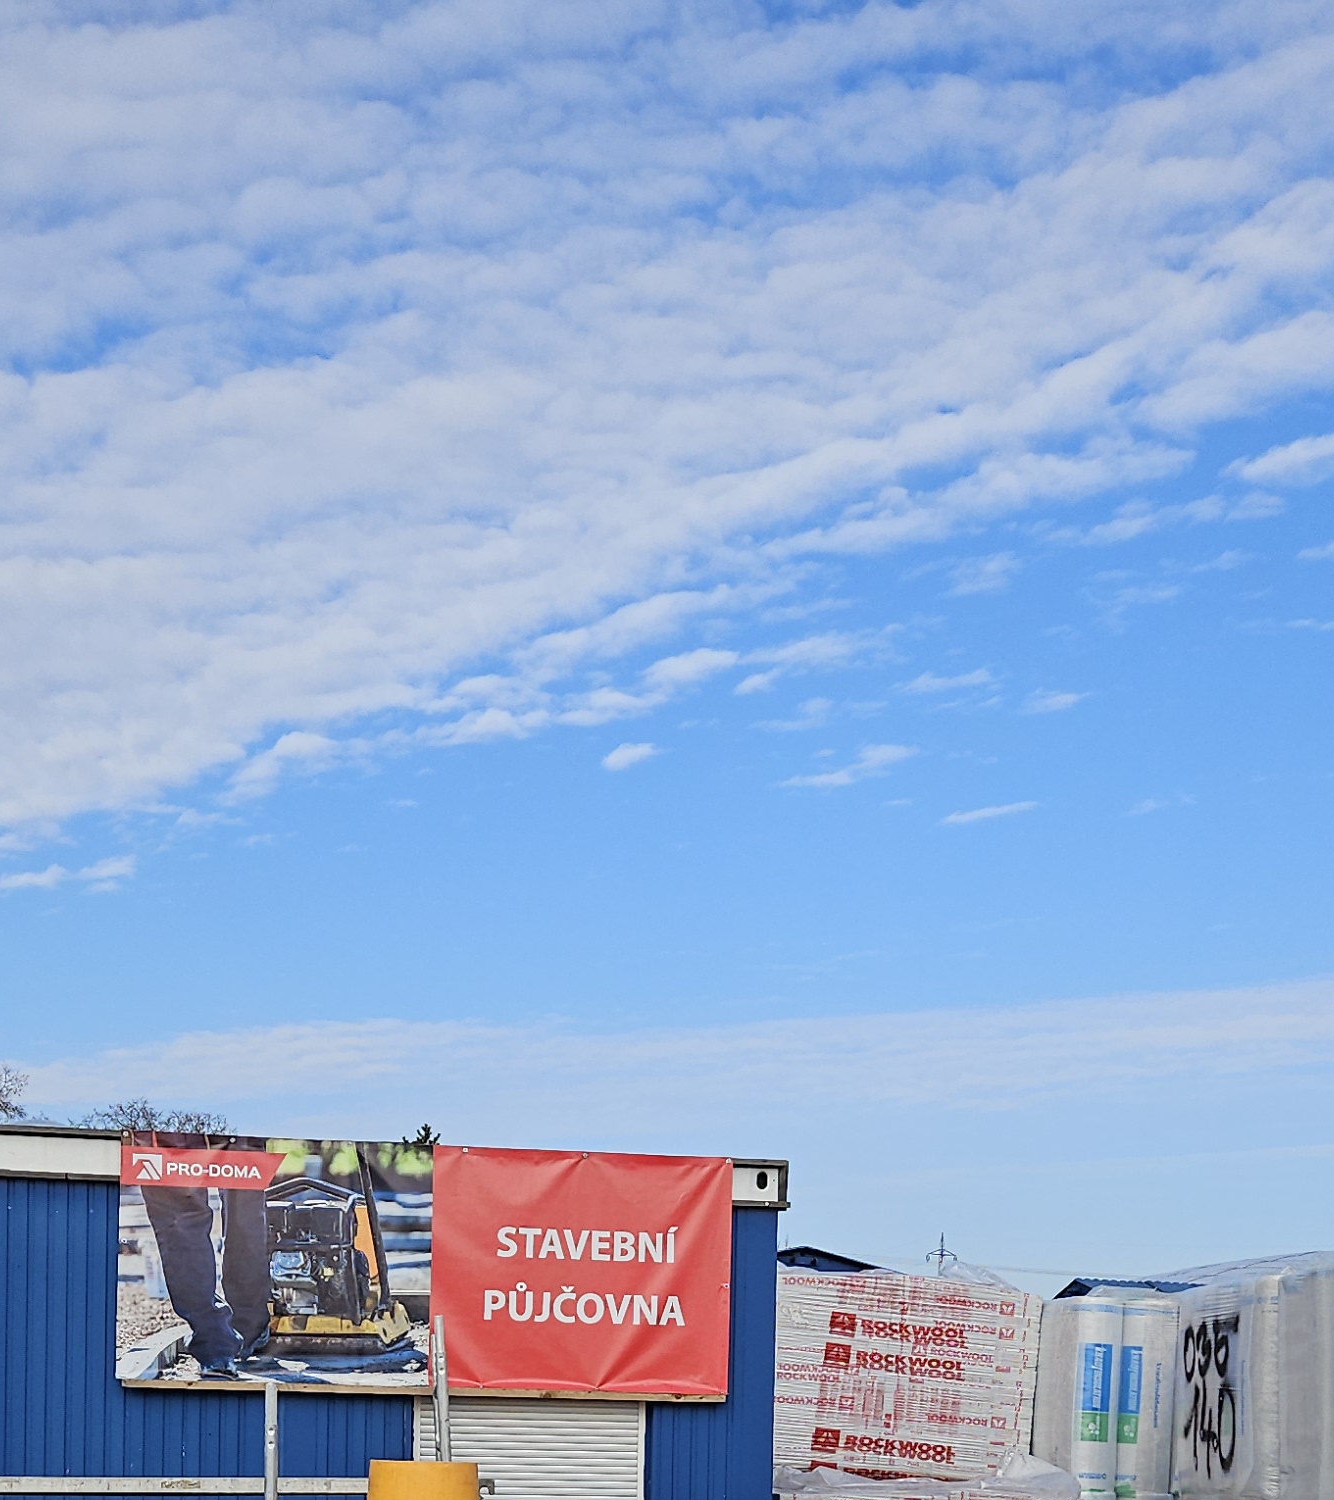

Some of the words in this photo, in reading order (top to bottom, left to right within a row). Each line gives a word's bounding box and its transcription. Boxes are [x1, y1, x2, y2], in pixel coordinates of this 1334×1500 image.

[167, 1163, 261, 1179] PRO-DOMA
[496, 1226, 678, 1264] STAVEBNÍ
[483, 1282, 685, 1326] PŮJČOVNA
[856, 1350, 965, 1372] ROCKWOOL
